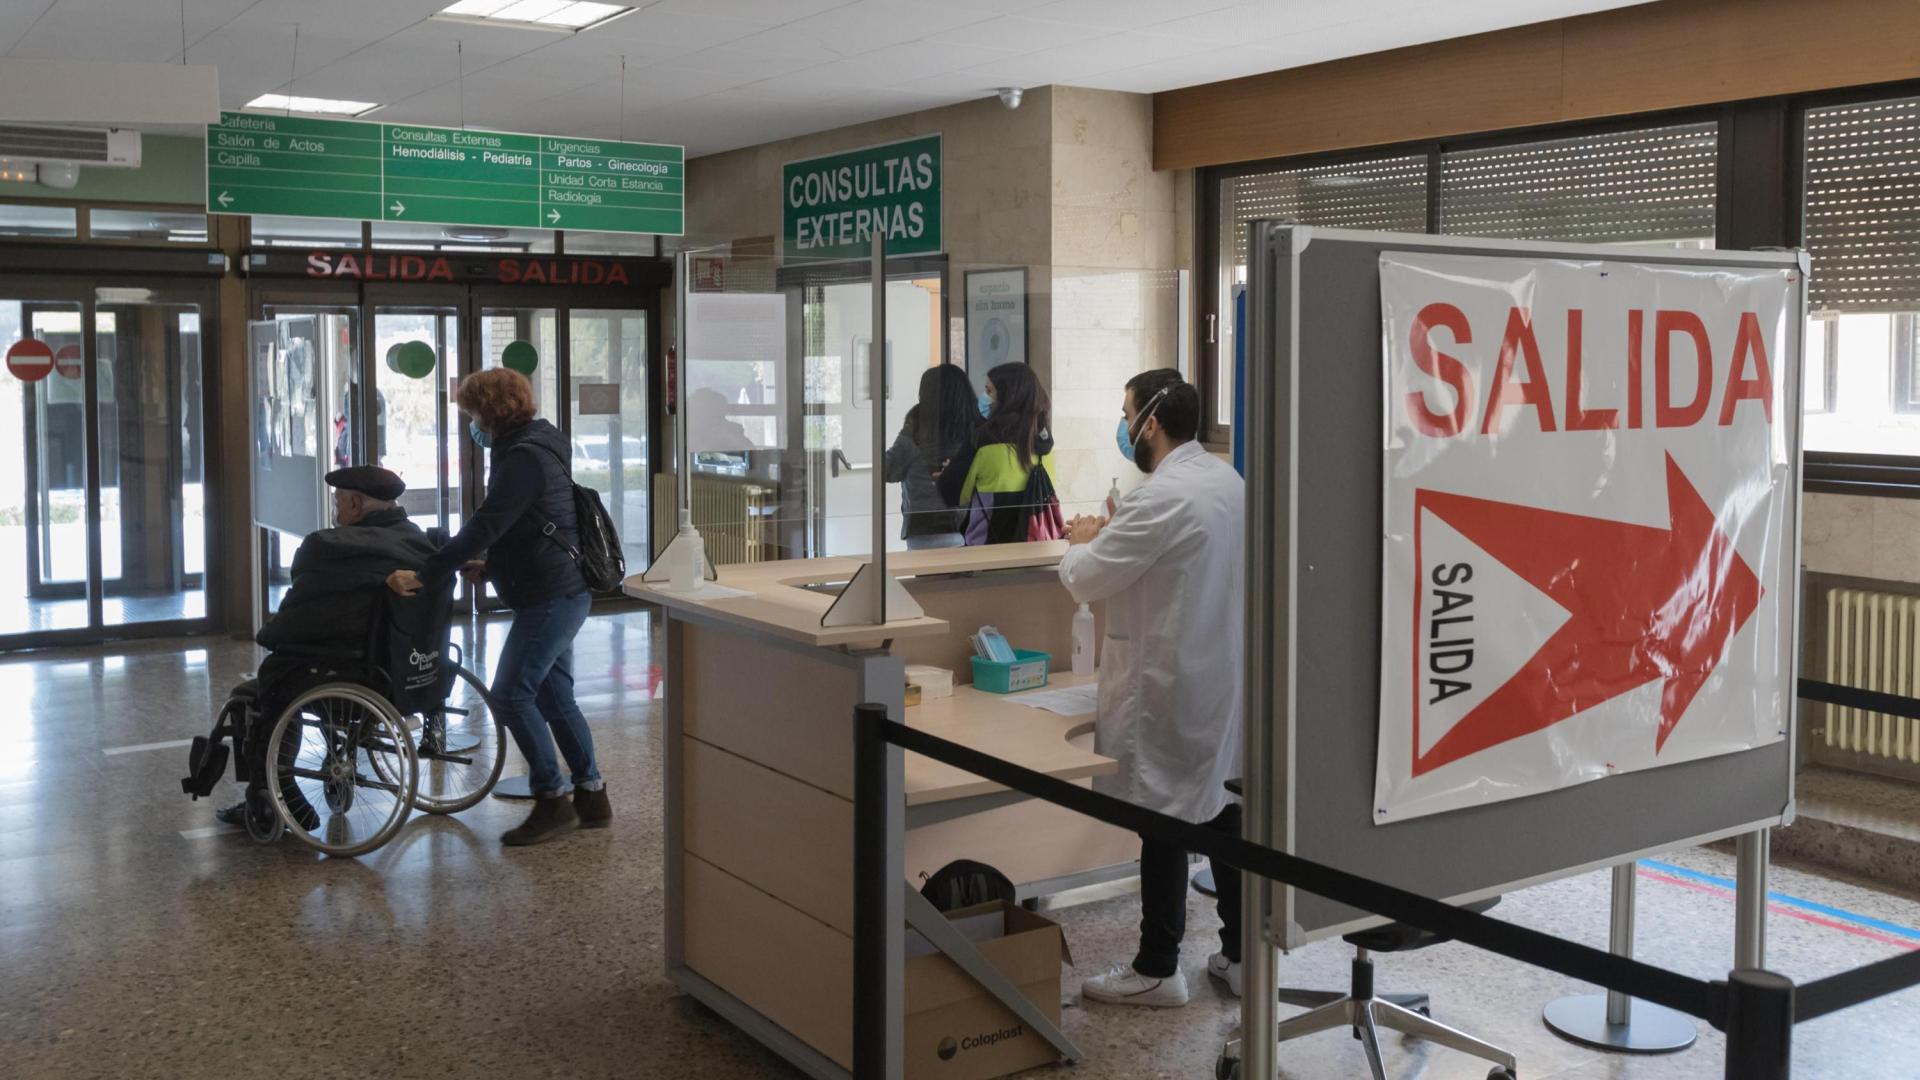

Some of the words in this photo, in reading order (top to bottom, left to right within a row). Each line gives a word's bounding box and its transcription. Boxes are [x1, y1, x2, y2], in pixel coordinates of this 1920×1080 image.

[217, 133, 255, 148] Salón
[263, 137, 280, 149] de
[289, 138, 325, 153] Actos
[392, 127, 447, 144] Consultas
[453, 132, 501, 147] Externas
[548, 139, 600, 155] Urgencias
[217, 151, 260, 167] Capilla
[392, 144, 466, 161] Hemodiálisis
[558, 156, 592, 169] Partos
[548, 172, 584, 186] Unidad
[588, 175, 617, 189] Corta
[622, 178, 664, 191] Estancia
[790, 152, 933, 209] CONSULTAS
[796, 201, 924, 250] EXTERNAS
[306, 253, 454, 281] SALIDA
[499, 259, 629, 286] SALIDA
[1405, 302, 1774, 438] SALIDA
[1429, 562, 1474, 706] SALIDA
[961, 1024, 1023, 1050] Coloplast
